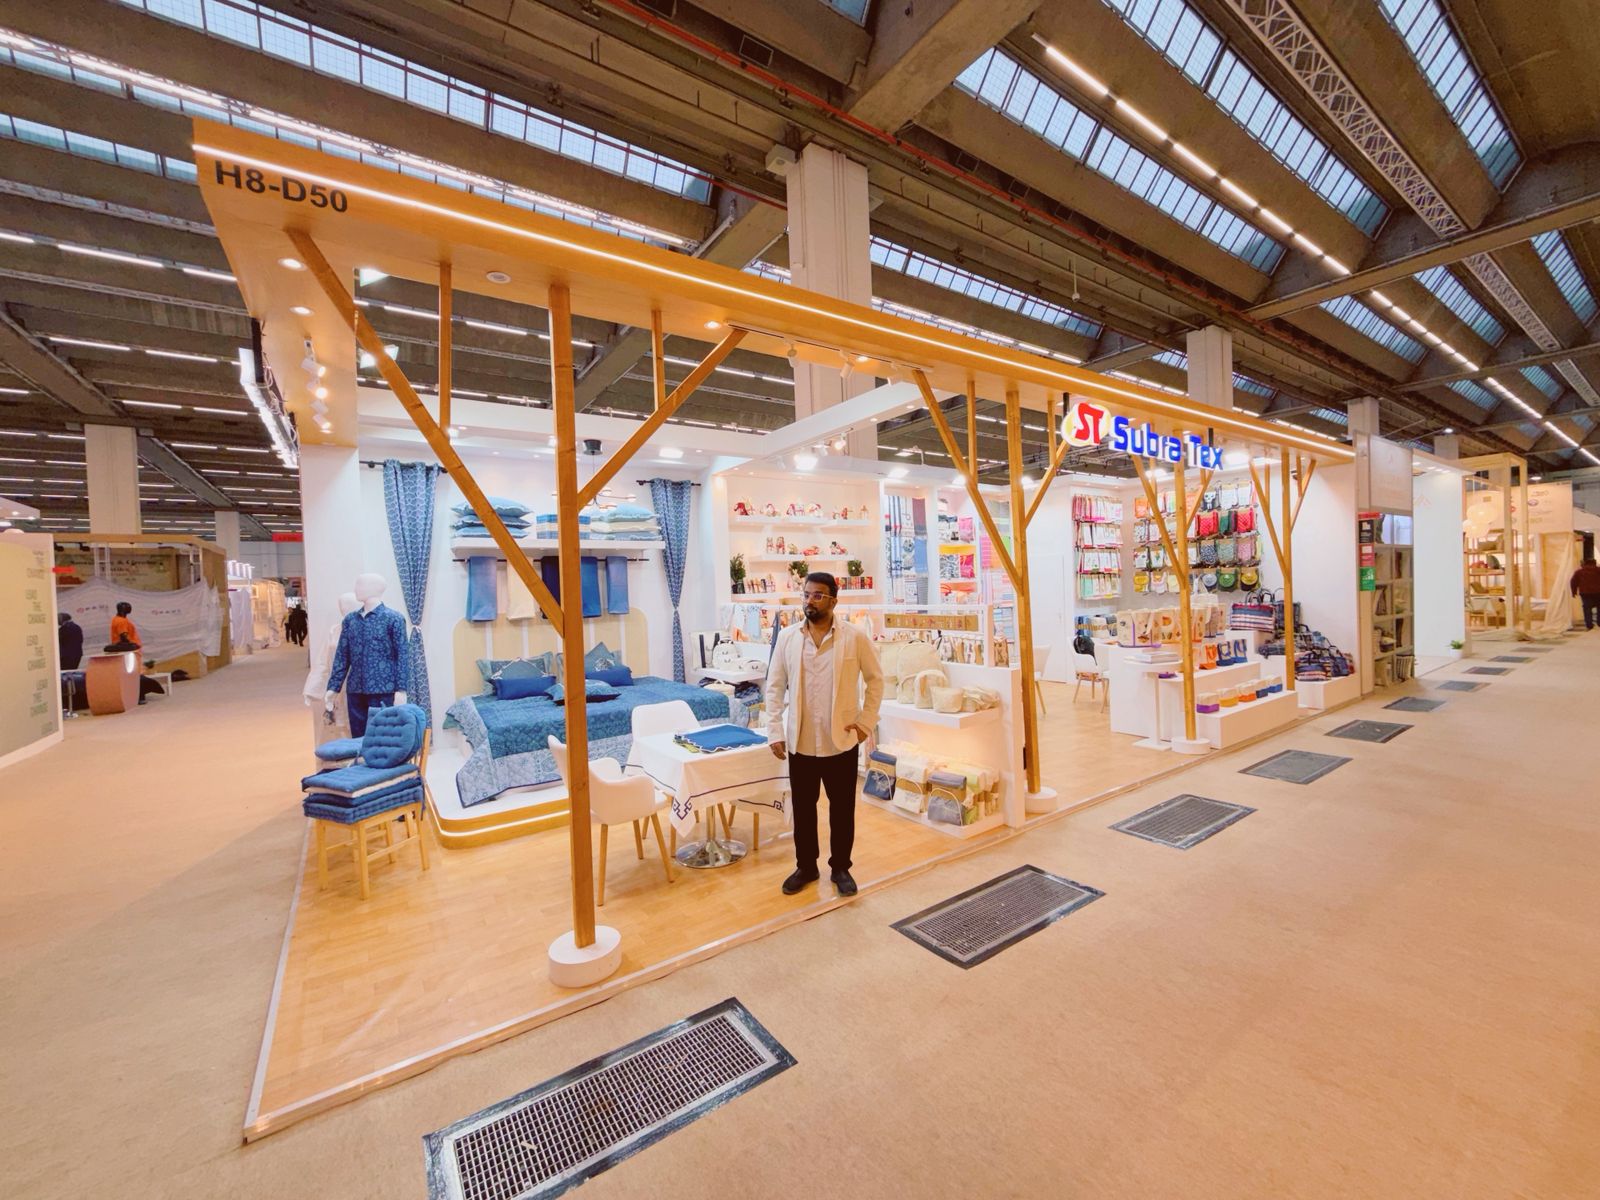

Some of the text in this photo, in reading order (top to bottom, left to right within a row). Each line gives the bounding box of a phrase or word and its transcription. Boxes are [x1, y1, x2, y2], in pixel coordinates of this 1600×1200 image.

[215, 160, 348, 213] H8-D50
[1074, 402, 1223, 470] ST Subra Tex
